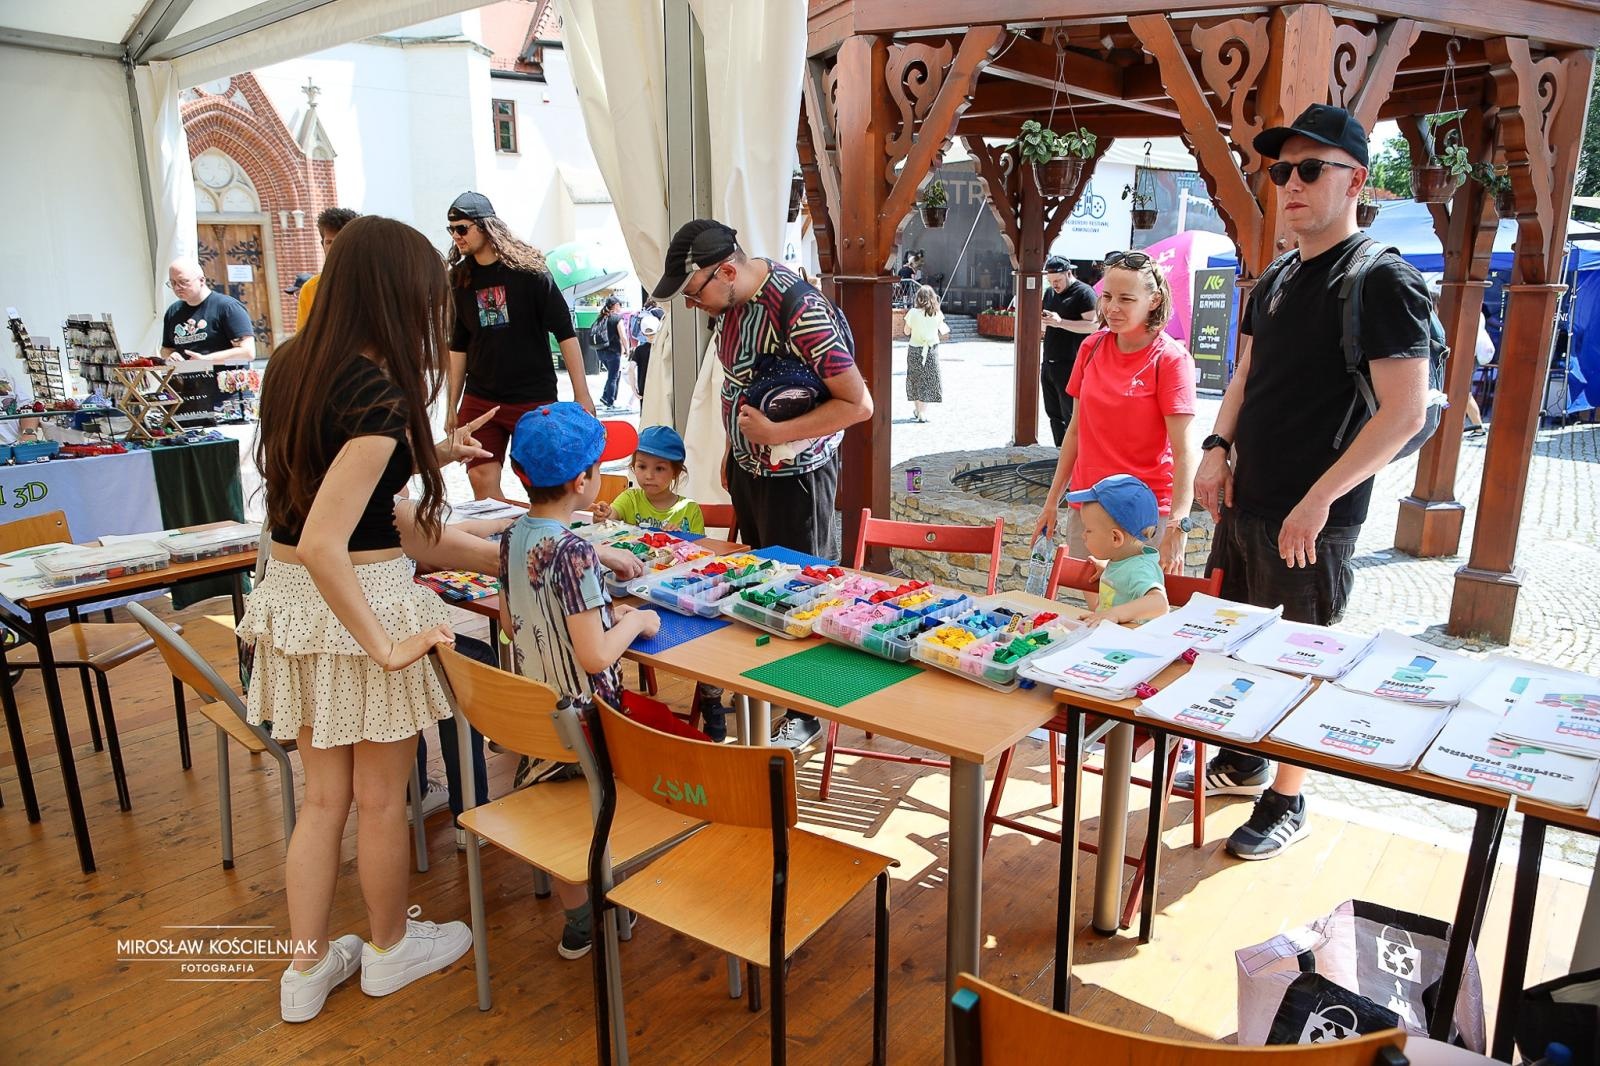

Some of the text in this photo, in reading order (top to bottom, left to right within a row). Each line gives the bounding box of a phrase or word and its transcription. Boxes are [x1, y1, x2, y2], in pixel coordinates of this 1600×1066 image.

[1199, 300, 1226, 309] GAMING
[13, 481, 48, 509] 3D
[1320, 723, 1397, 744] SKELETON
[1438, 745, 1575, 782] ZOMBIE PIGMAN
